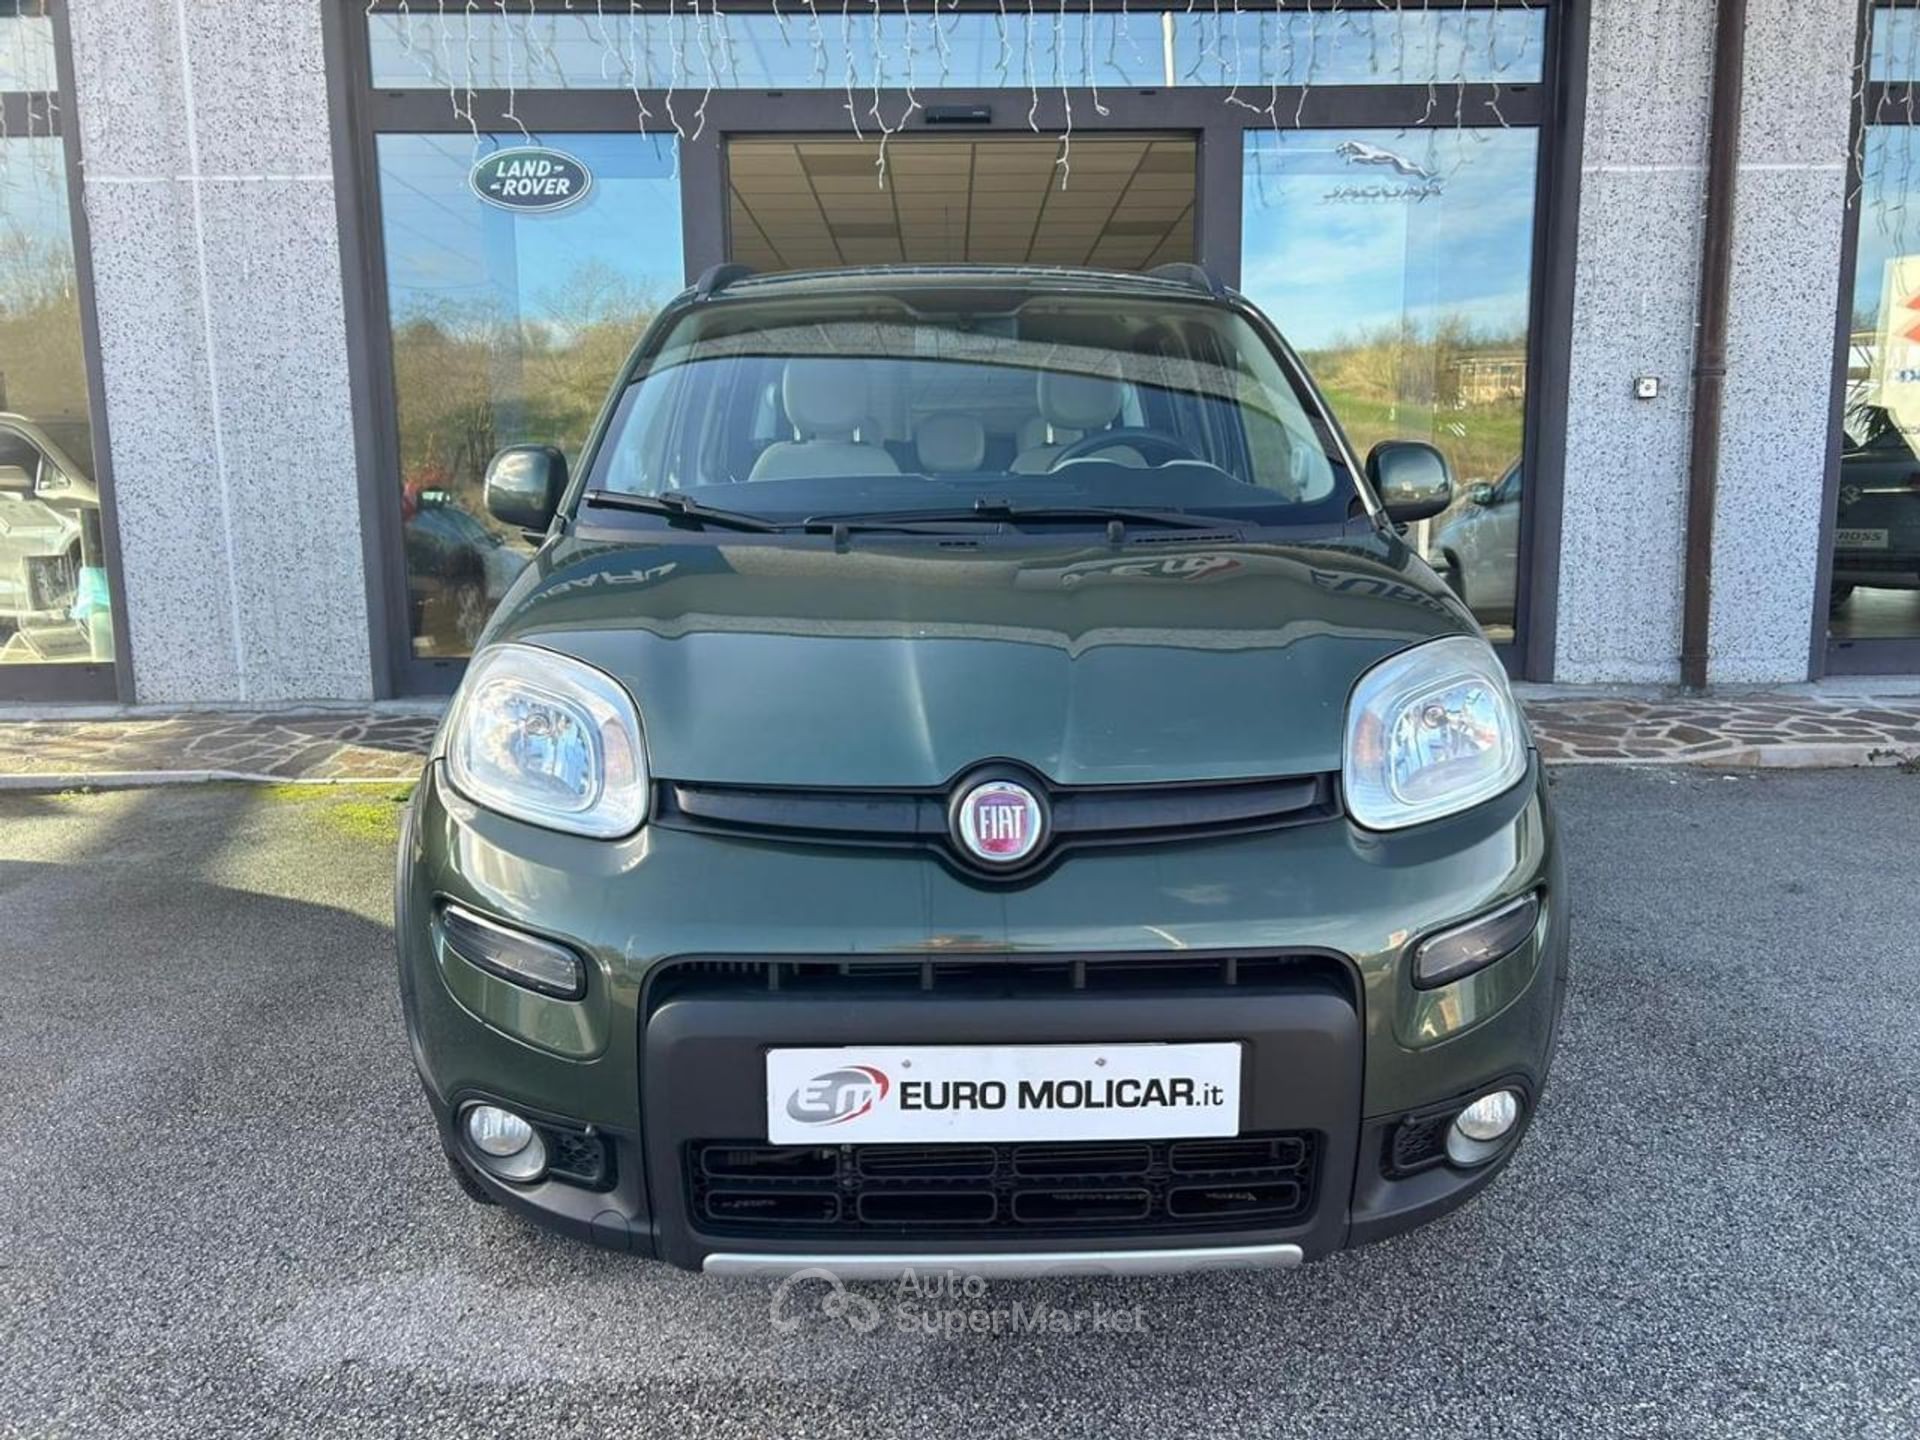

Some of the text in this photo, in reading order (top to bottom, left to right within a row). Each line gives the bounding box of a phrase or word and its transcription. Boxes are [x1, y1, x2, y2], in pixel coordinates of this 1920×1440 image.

[496, 160, 551, 178] LAND
[501, 178, 570, 196] ROVER
[980, 805, 1024, 840] FIAT
[899, 1081, 1006, 1110] EURO
[1018, 1077, 1224, 1109] MOLICAR.it
